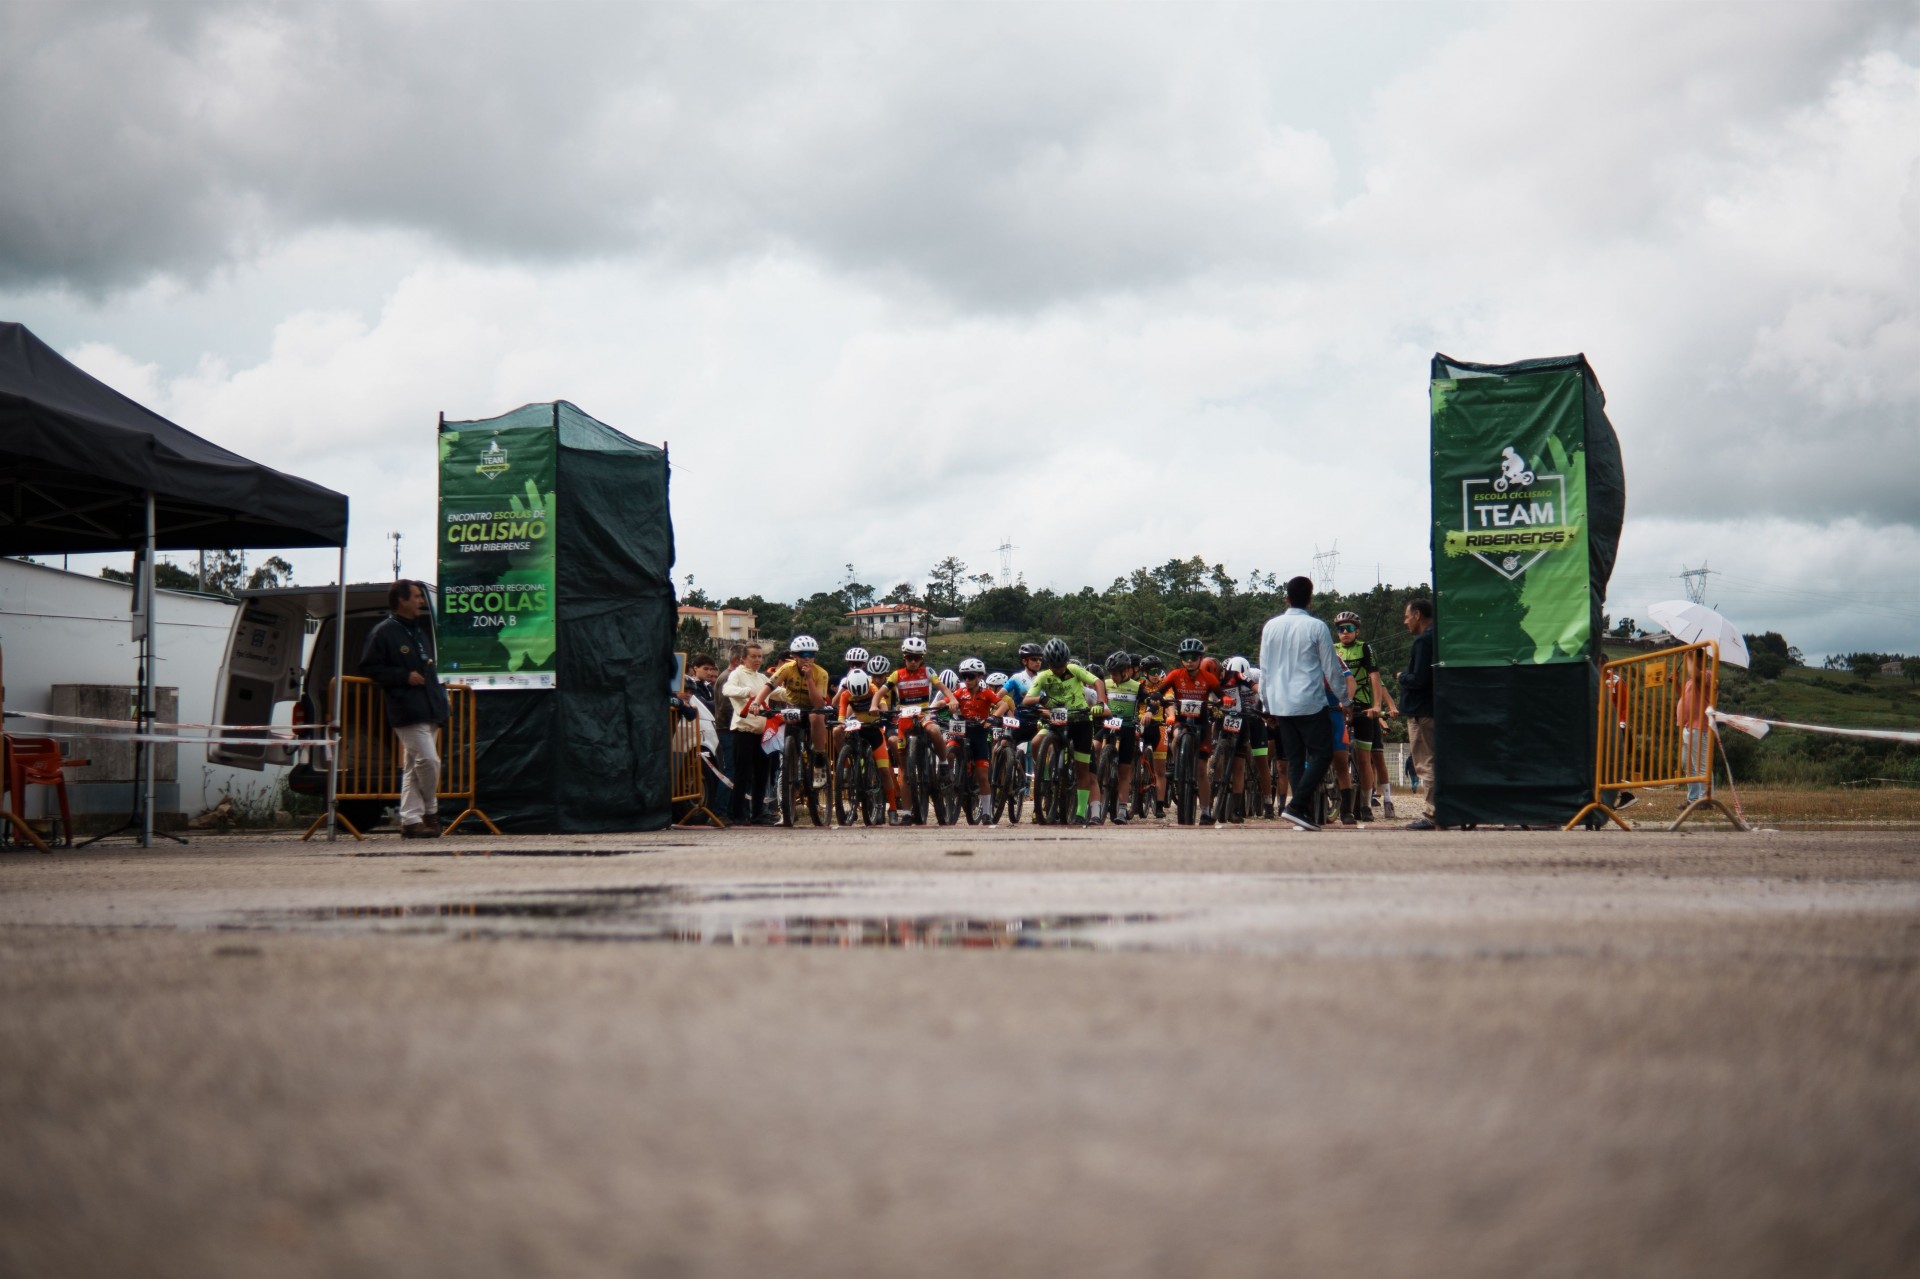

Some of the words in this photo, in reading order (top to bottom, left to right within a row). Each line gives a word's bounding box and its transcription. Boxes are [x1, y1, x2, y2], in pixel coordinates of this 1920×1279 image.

[484, 456, 504, 464] TEAM
[1474, 493, 1508, 501] ESCOLA
[1509, 490, 1553, 499] CICLISMO
[447, 512, 492, 522] ENCONTRO
[493, 510, 532, 520] ESCOLAS
[533, 510, 546, 518] DE
[1474, 502, 1554, 526] TEAM
[447, 520, 546, 543] CICLISMO
[1466, 531, 1565, 547] RIBEIRENSE
[460, 543, 482, 553] TEAM
[482, 541, 531, 551] RIBEIRENSE
[445, 585, 484, 593] ENCONTRO
[485, 584, 505, 592] INTER
[506, 583, 547, 592] REGIONAL
[445, 591, 547, 613] ESCOLAS
[473, 615, 506, 627] ZONA
[509, 615, 517, 627] B
[1185, 703, 1197, 712] 37
[1005, 718, 1019, 726] 147
[1050, 712, 1066, 721] 148
[952, 724, 962, 733] 48
[1225, 719, 1240, 729] 323
